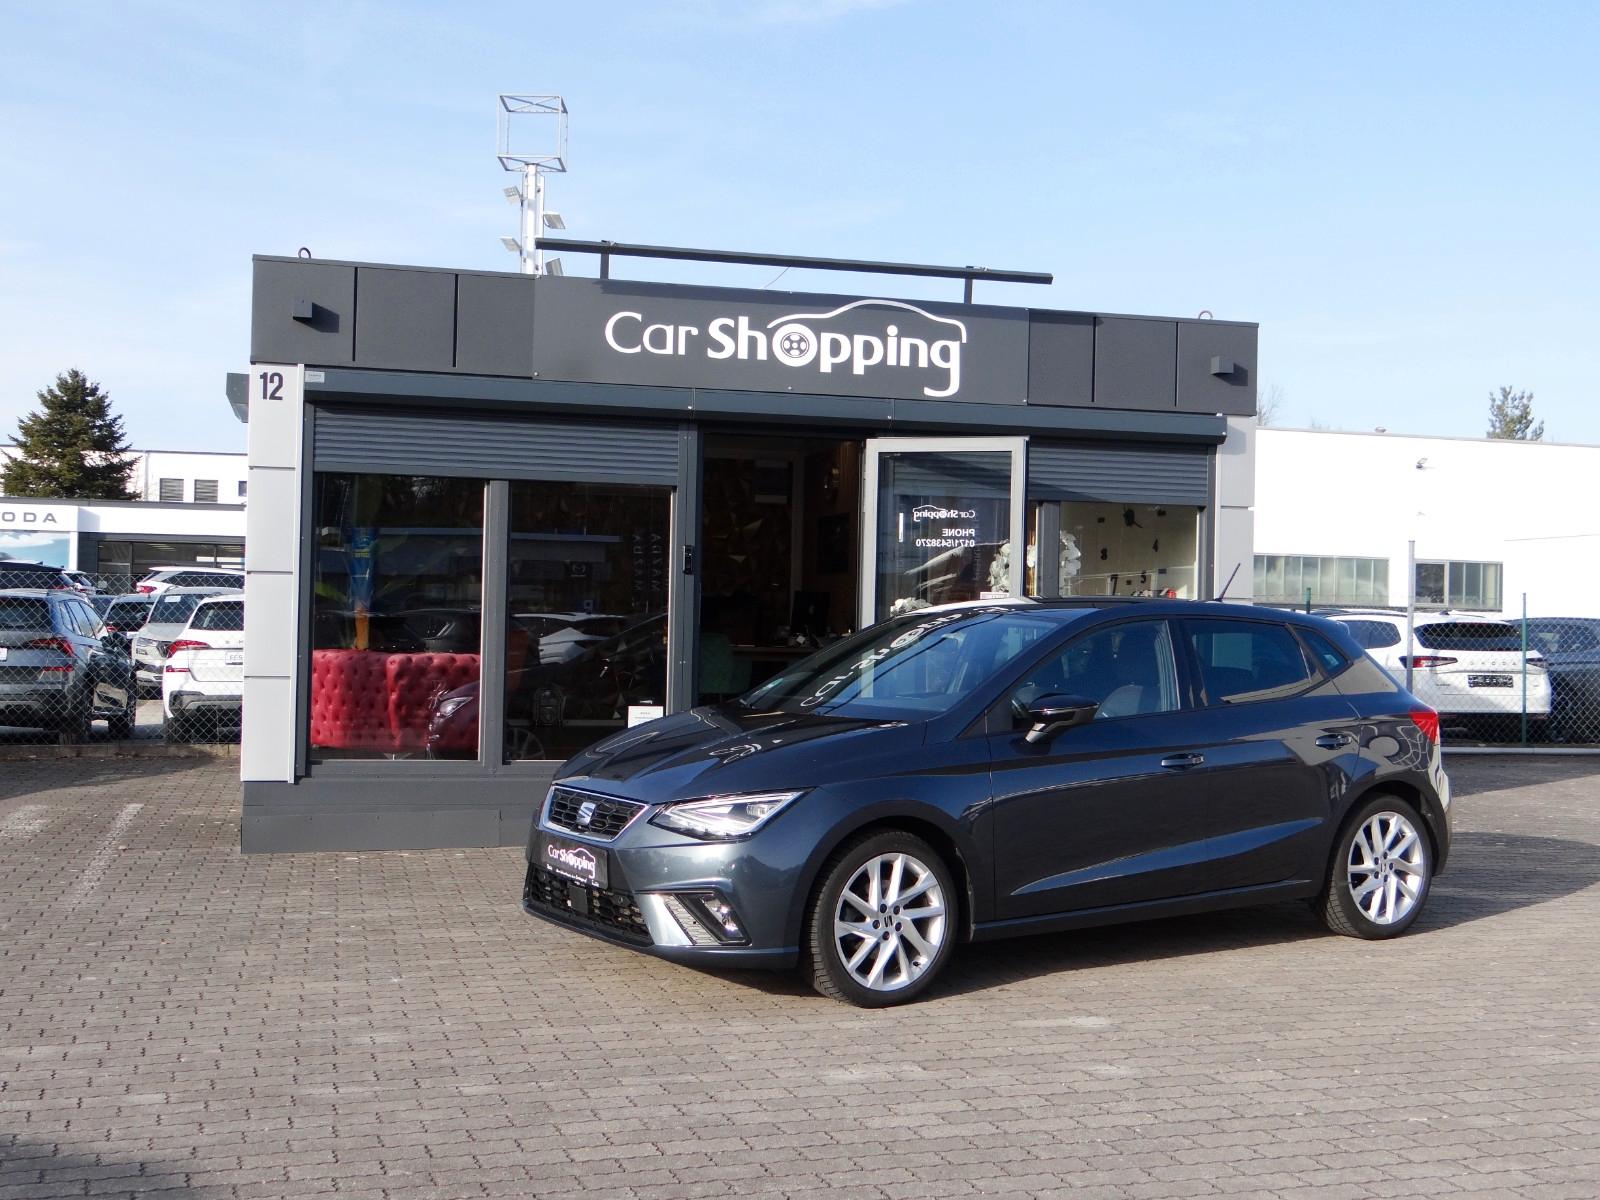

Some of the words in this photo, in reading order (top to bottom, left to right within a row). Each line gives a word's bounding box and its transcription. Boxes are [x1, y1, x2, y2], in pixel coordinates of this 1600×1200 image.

[605, 311, 698, 356] Car
[707, 316, 964, 397] Shopping
[259, 372, 284, 401] 12
[548, 844, 559, 858] Car
[559, 848, 596, 879] Shopping
